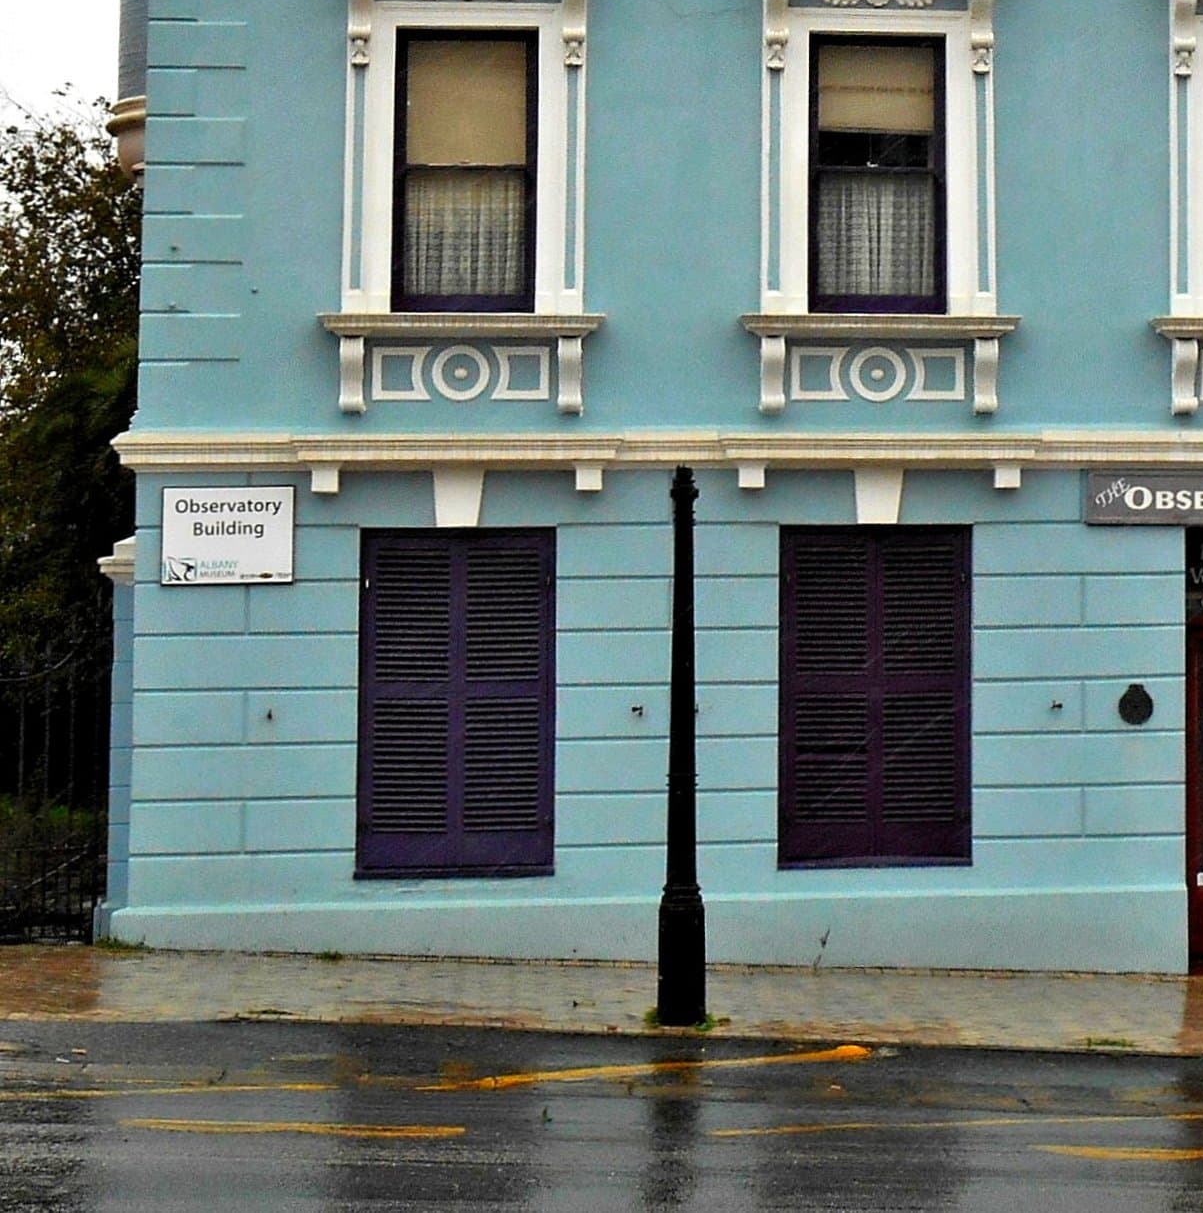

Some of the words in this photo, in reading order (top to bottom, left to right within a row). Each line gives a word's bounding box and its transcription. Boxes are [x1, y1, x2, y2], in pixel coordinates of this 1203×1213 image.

[1095, 477, 1132, 508] THE
[175, 499, 282, 515] Observatory
[193, 521, 264, 538] Building
